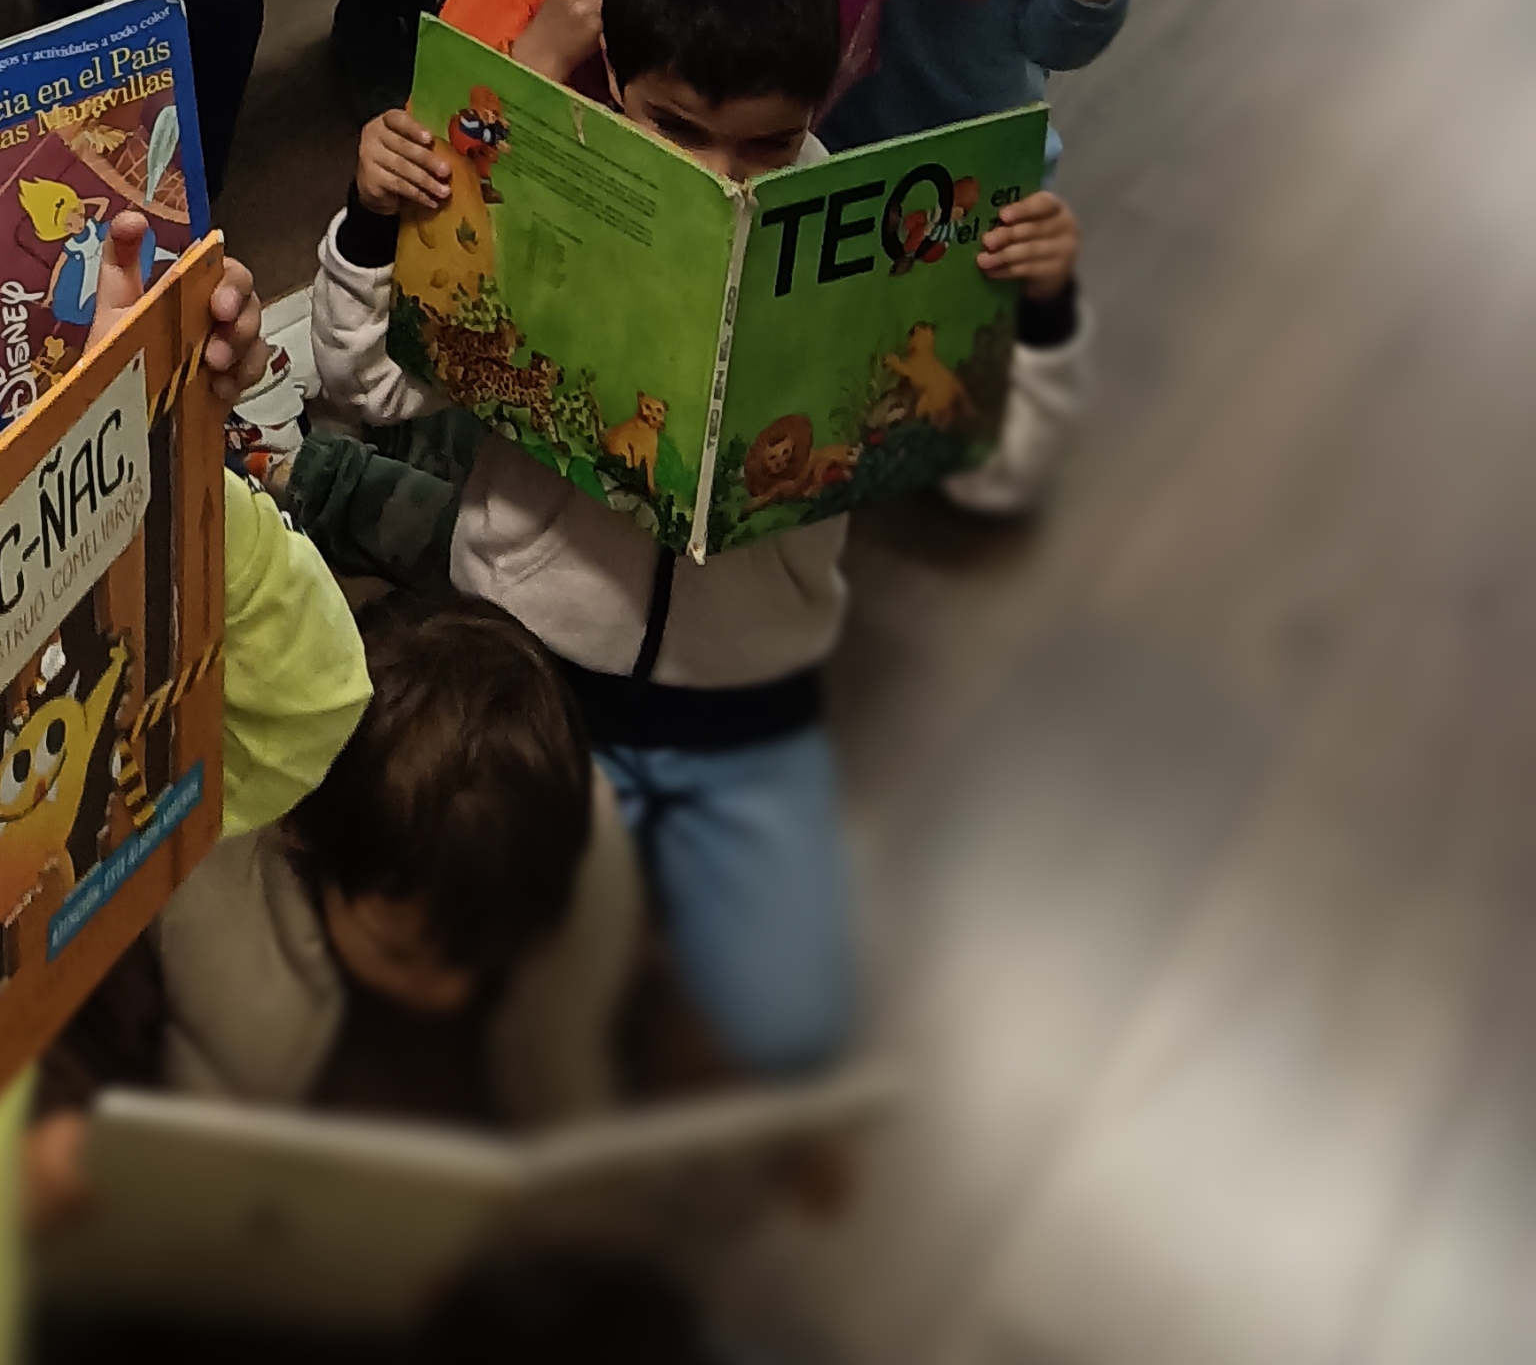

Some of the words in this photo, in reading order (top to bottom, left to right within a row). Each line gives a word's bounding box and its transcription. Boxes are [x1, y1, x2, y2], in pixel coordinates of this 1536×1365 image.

[34, 66, 176, 136] Maravillas
[37, 76, 74, 105] en
[78, 55, 105, 90] el
[108, 36, 172, 79] País
[760, 162, 956, 299] TEO
[957, 215, 980, 245] el
